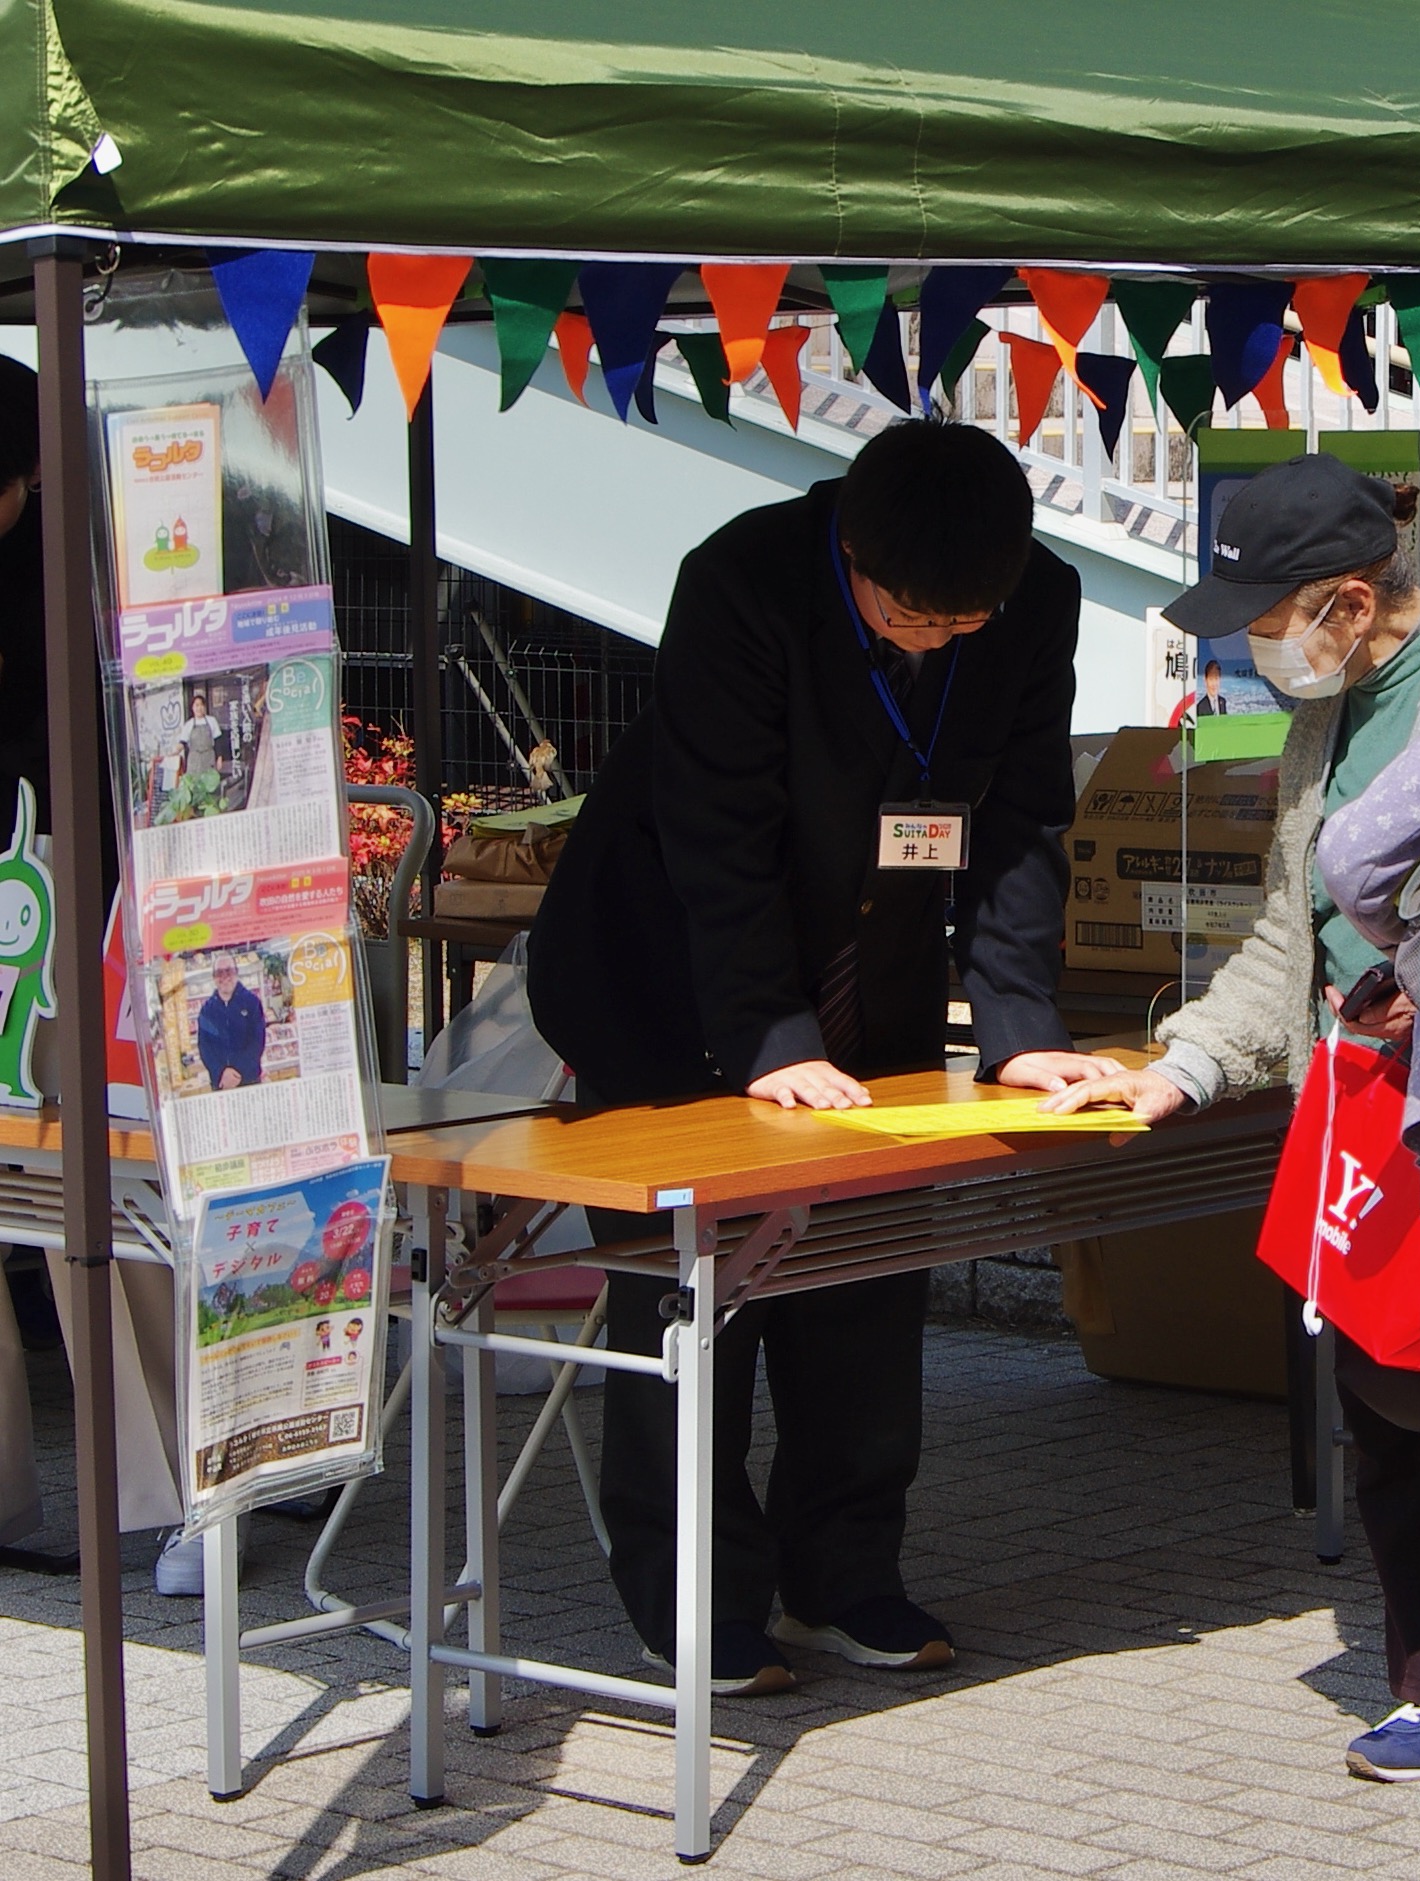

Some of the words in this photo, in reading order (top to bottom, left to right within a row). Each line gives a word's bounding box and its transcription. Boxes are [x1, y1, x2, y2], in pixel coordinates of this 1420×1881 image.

[132, 439, 203, 472] ラコルタ
[121, 599, 227, 652] ラコルタ
[282, 667, 306, 687] Be
[269, 678, 318, 713] Social
[902, 843, 938, 860] 井上
[154, 874, 253, 924] ラコルタ
[303, 940, 328, 959] Be
[291, 953, 340, 986] Social
[1328, 1150, 1384, 1230] Y!
[226, 1218, 280, 1241] 子育て
[212, 1252, 283, 1278] デジタル
